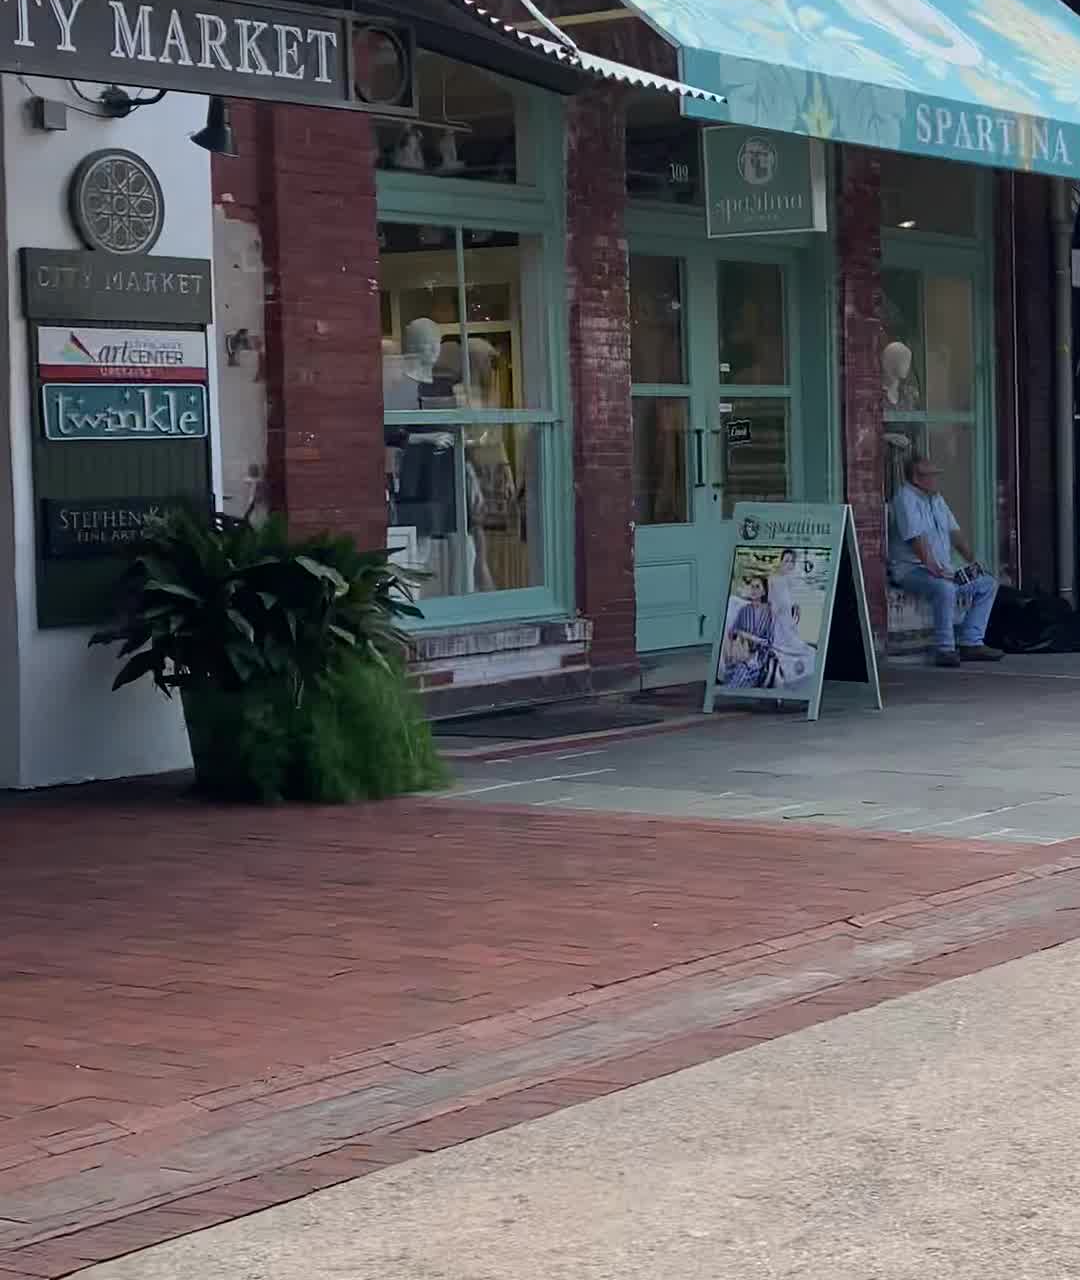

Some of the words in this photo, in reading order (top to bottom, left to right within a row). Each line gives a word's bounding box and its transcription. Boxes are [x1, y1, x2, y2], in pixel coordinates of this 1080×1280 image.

[108, 0, 338, 84] MARKET
[915, 102, 1073, 166] SPARTINA
[103, 269, 204, 295] MARKET
[98, 340, 129, 365] art
[130, 348, 185, 366] CENTER
[53, 387, 200, 436] twinkle
